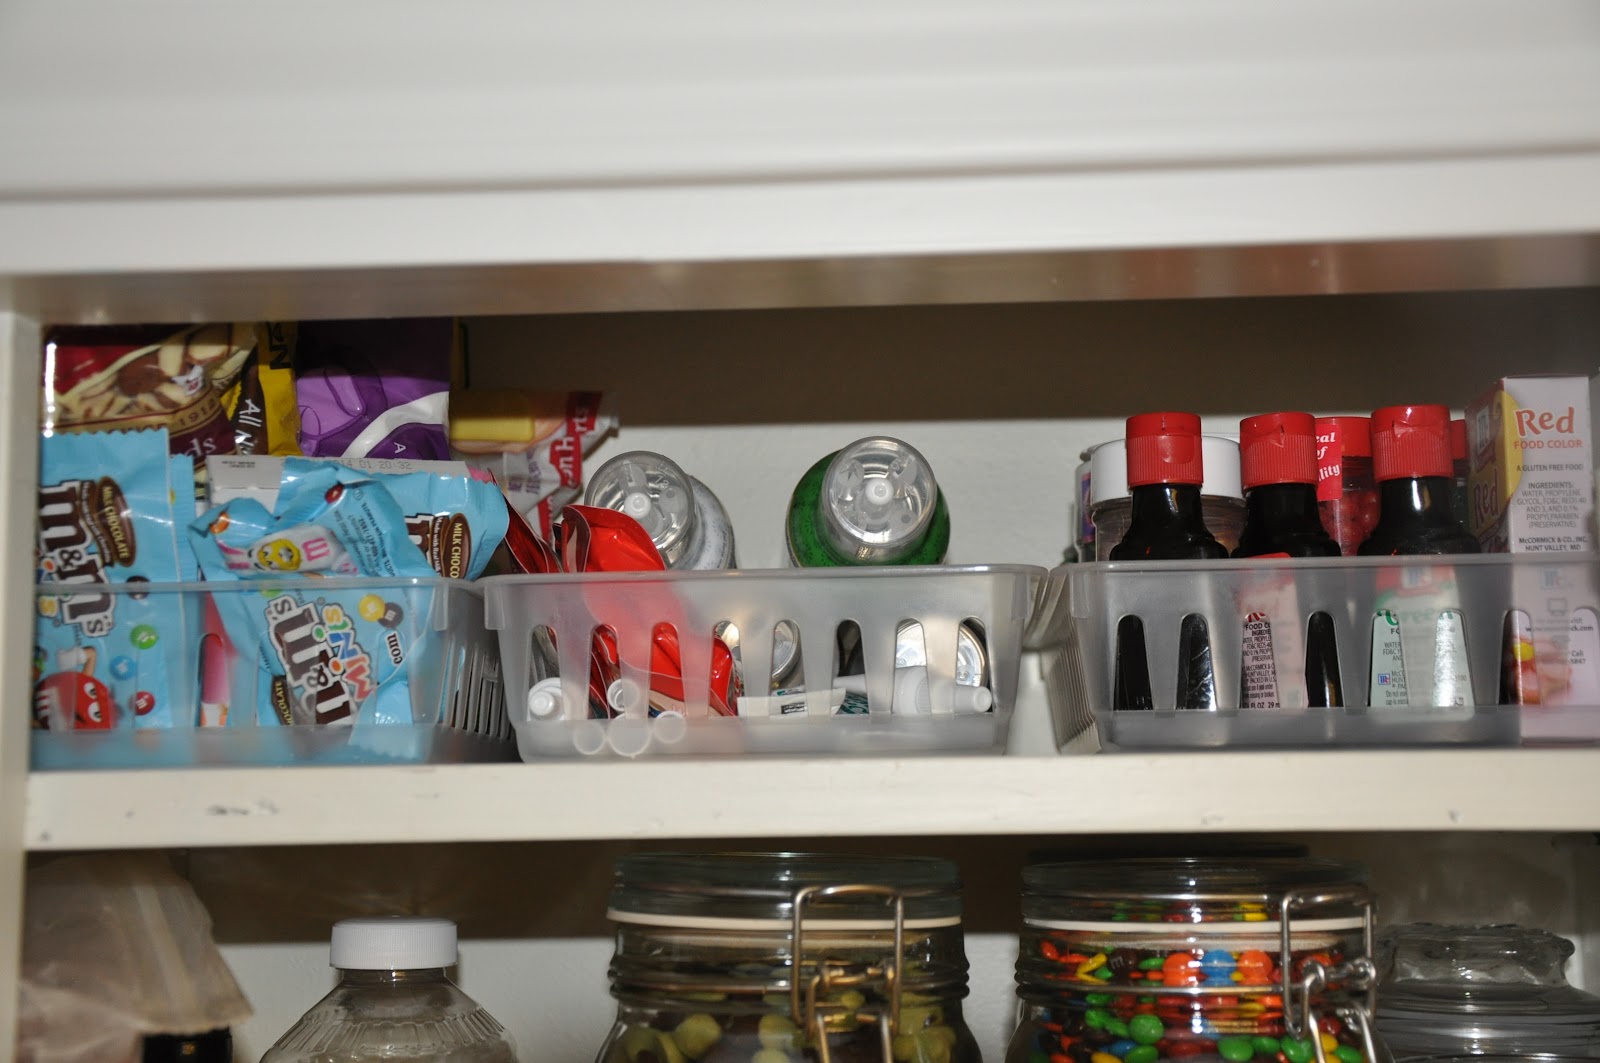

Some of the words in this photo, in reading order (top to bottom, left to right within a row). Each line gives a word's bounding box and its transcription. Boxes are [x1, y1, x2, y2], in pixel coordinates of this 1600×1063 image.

[1515, 406, 1575, 437] Red
[1514, 440, 1544, 450] FOOD
[1547, 439, 1582, 449] COLOR
[1318, 464, 1341, 481] lity
[1522, 464, 1548, 472] GLUTEN
[1548, 463, 1565, 471] FREE
[1565, 463, 1584, 471] FOOD
[1473, 468, 1499, 530] Red
[1548, 505, 1563, 513] AND
[103, 505, 130, 559] CHOCOLATE
[453, 522, 464, 546] MILK
[1525, 544, 1543, 552] HUNT
[1570, 543, 1581, 551] MD
[449, 546, 462, 579] CHOCO
[1245, 622, 1263, 631] FOOD
